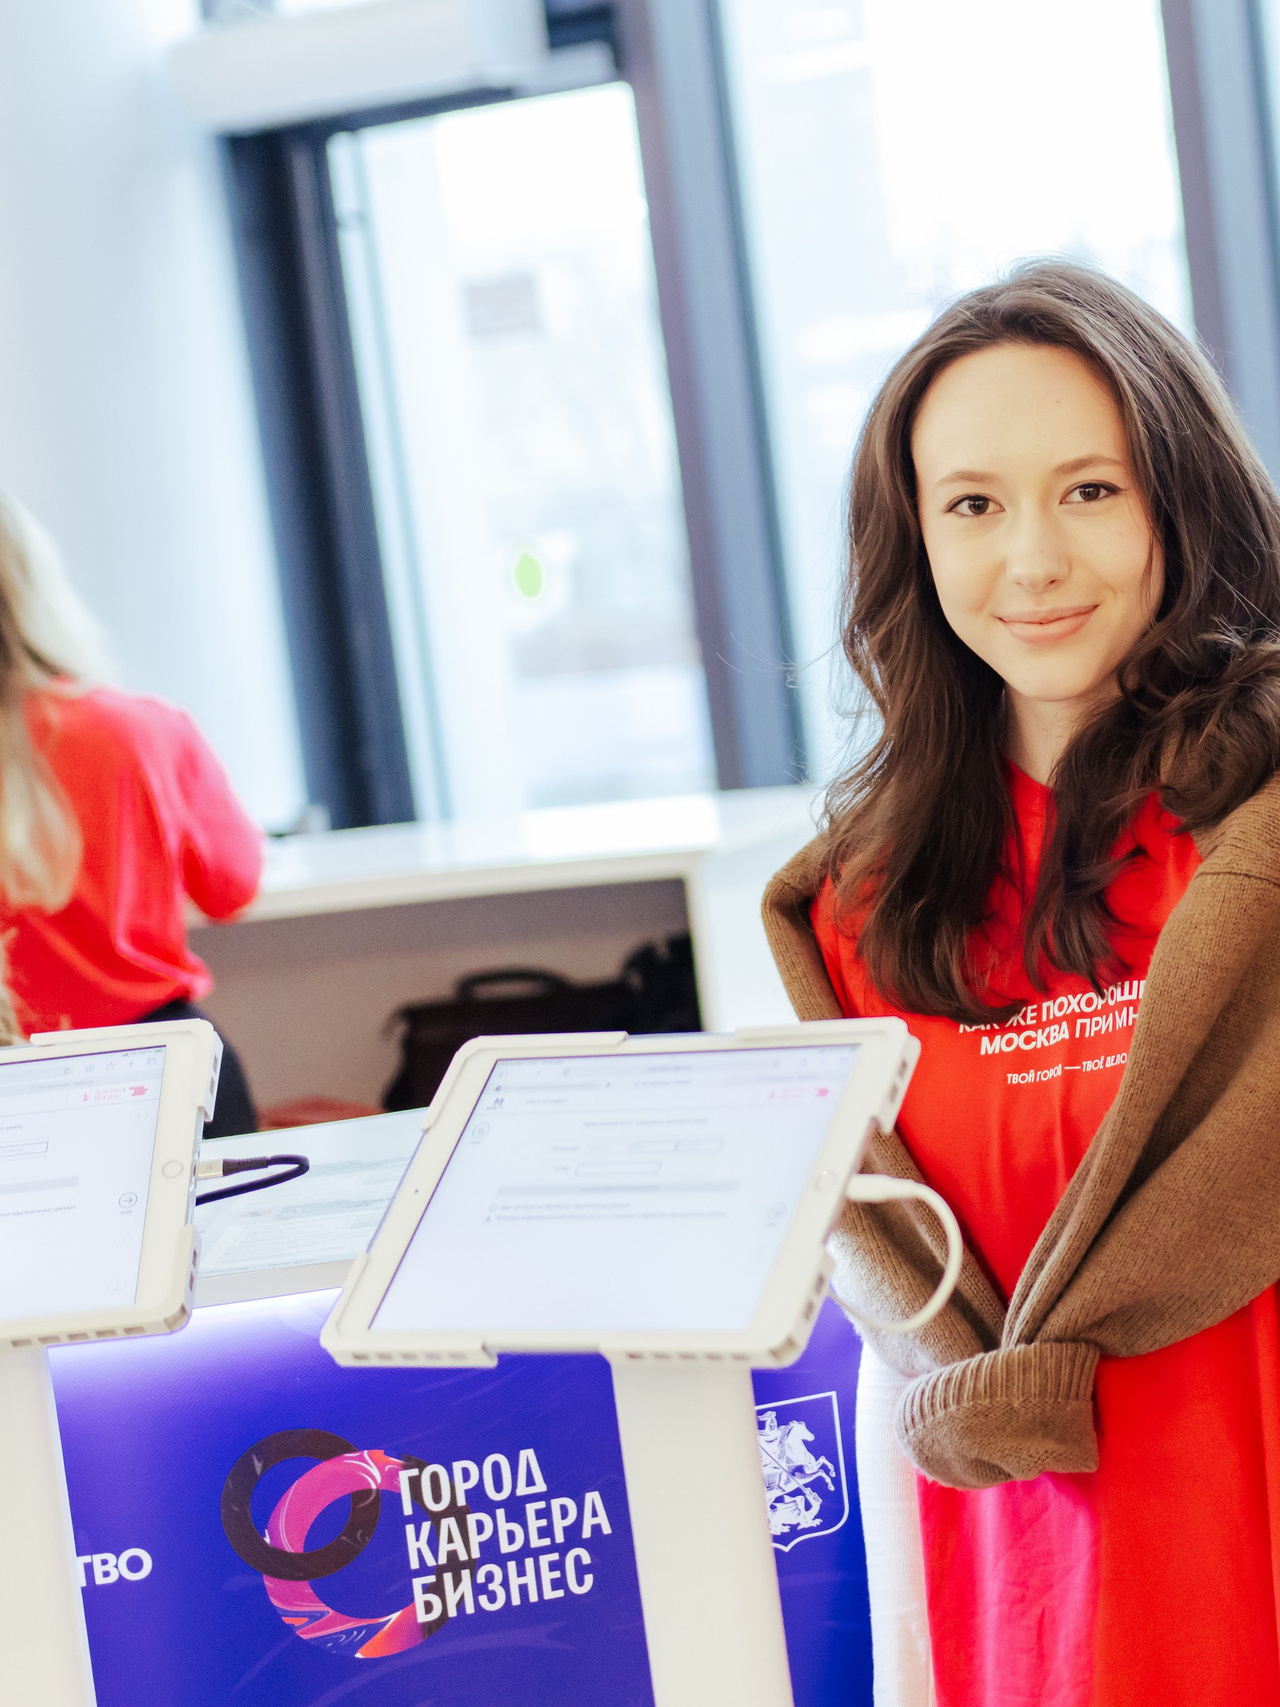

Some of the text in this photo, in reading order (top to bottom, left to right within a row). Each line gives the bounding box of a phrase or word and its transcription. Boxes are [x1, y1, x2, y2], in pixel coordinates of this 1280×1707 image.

[980, 1020, 1070, 1056] МОСКВА
[1075, 1012, 1113, 1039] ПРИ
[1006, 1069, 1035, 1085] ТВОЙ
[1036, 1064, 1062, 1082] ГОРОД
[1082, 1055, 1105, 1073] ТВОЁ
[1105, 1052, 1128, 1068] ДЕЛО
[398, 1448, 548, 1517] ГОРОД
[405, 1491, 613, 1570] КАРЬЕРА
[411, 1547, 595, 1624] БИЗНЕС
